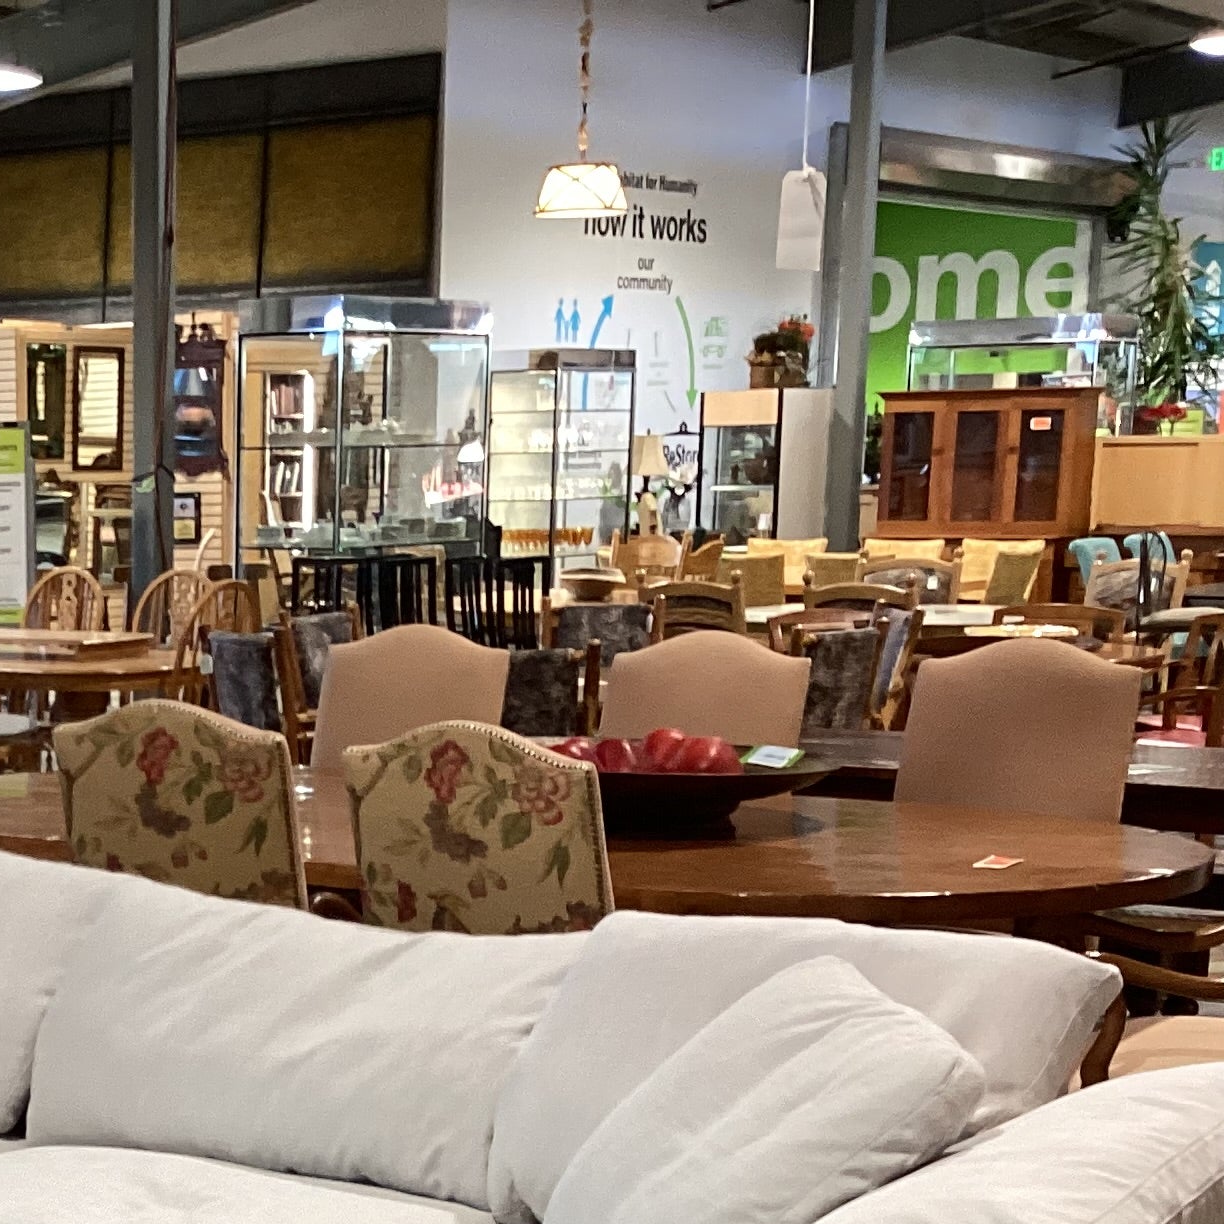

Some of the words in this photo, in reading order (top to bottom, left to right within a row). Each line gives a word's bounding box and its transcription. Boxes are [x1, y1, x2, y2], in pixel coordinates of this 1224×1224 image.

[632, 204, 644, 239] it
[650, 209, 707, 244] works
[637, 257, 655, 271] our
[617, 274, 673, 295] community
